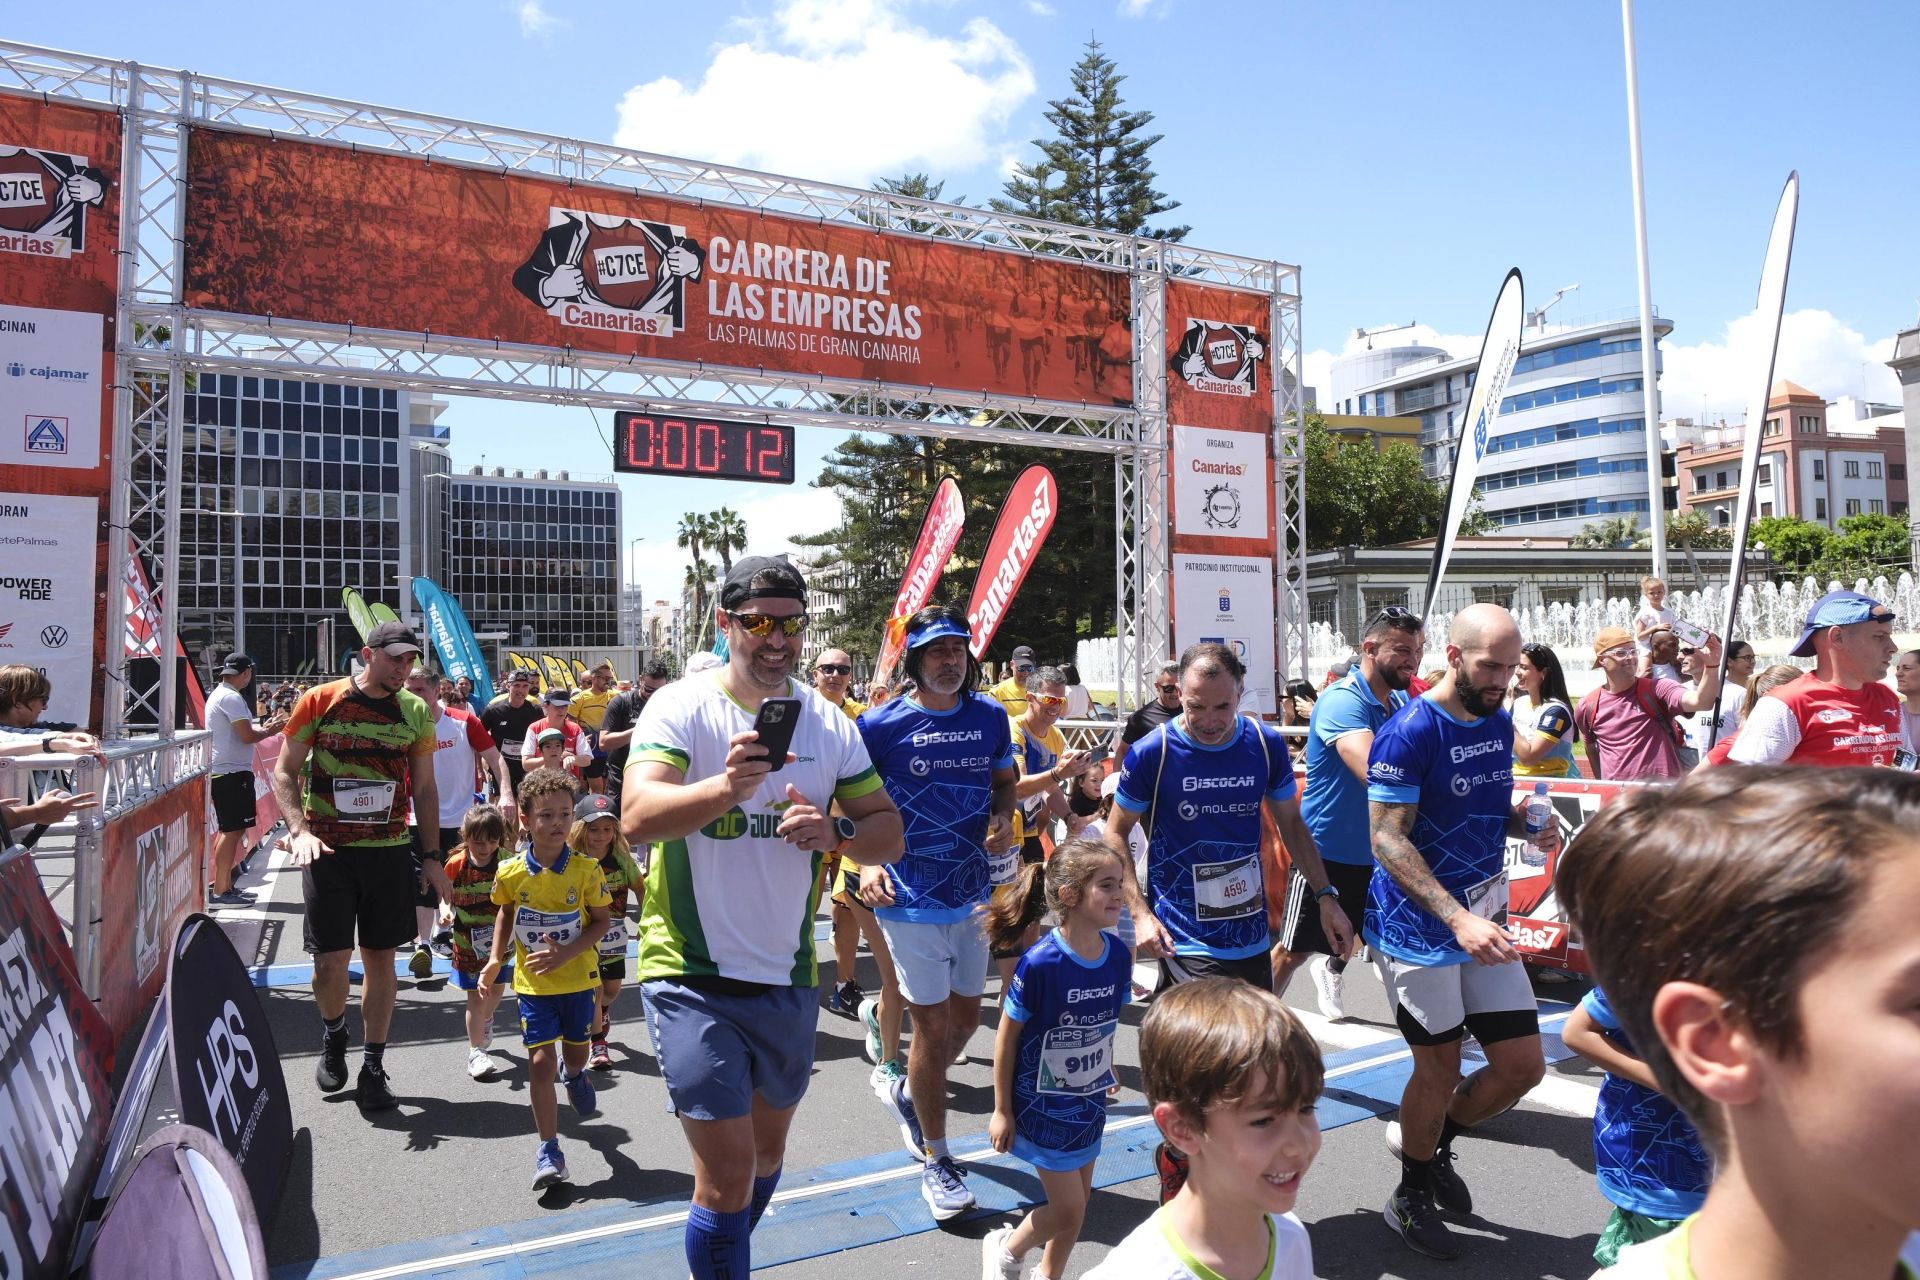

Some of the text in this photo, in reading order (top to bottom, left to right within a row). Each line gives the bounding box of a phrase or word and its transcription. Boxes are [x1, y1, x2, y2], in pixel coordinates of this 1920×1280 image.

[598, 251, 646, 276] #C7CE
[708, 236, 891, 296] CARRERA DE
[708, 279, 922, 340] LAS EMPRESAS
[564, 304, 669, 336] Canarias7
[708, 322, 921, 364] LAS PALMAS DE GRAN CANARIA
[1211, 344, 1236, 359] #C7CE
[29, 366, 90, 380] cajamar
[1196, 378, 1249, 395] Canarias7
[32, 442, 61, 451] ALDI
[1206, 438, 1234, 449] ORGANIZA
[1192, 459, 1248, 476] Canarias7
[0, 505, 28, 518] RAN
[968, 474, 1051, 657] Canarias7
[1184, 562, 1262, 574] PATROCINIO INSTITUCIONAL
[933, 756, 990, 770] MOLECOR
[352, 795, 374, 808] 4901
[1224, 879, 1248, 898] 4592
[1050, 1030, 1082, 1041] HPS
[1065, 1048, 1104, 1074] 9119
[196, 999, 259, 1147] HPS
